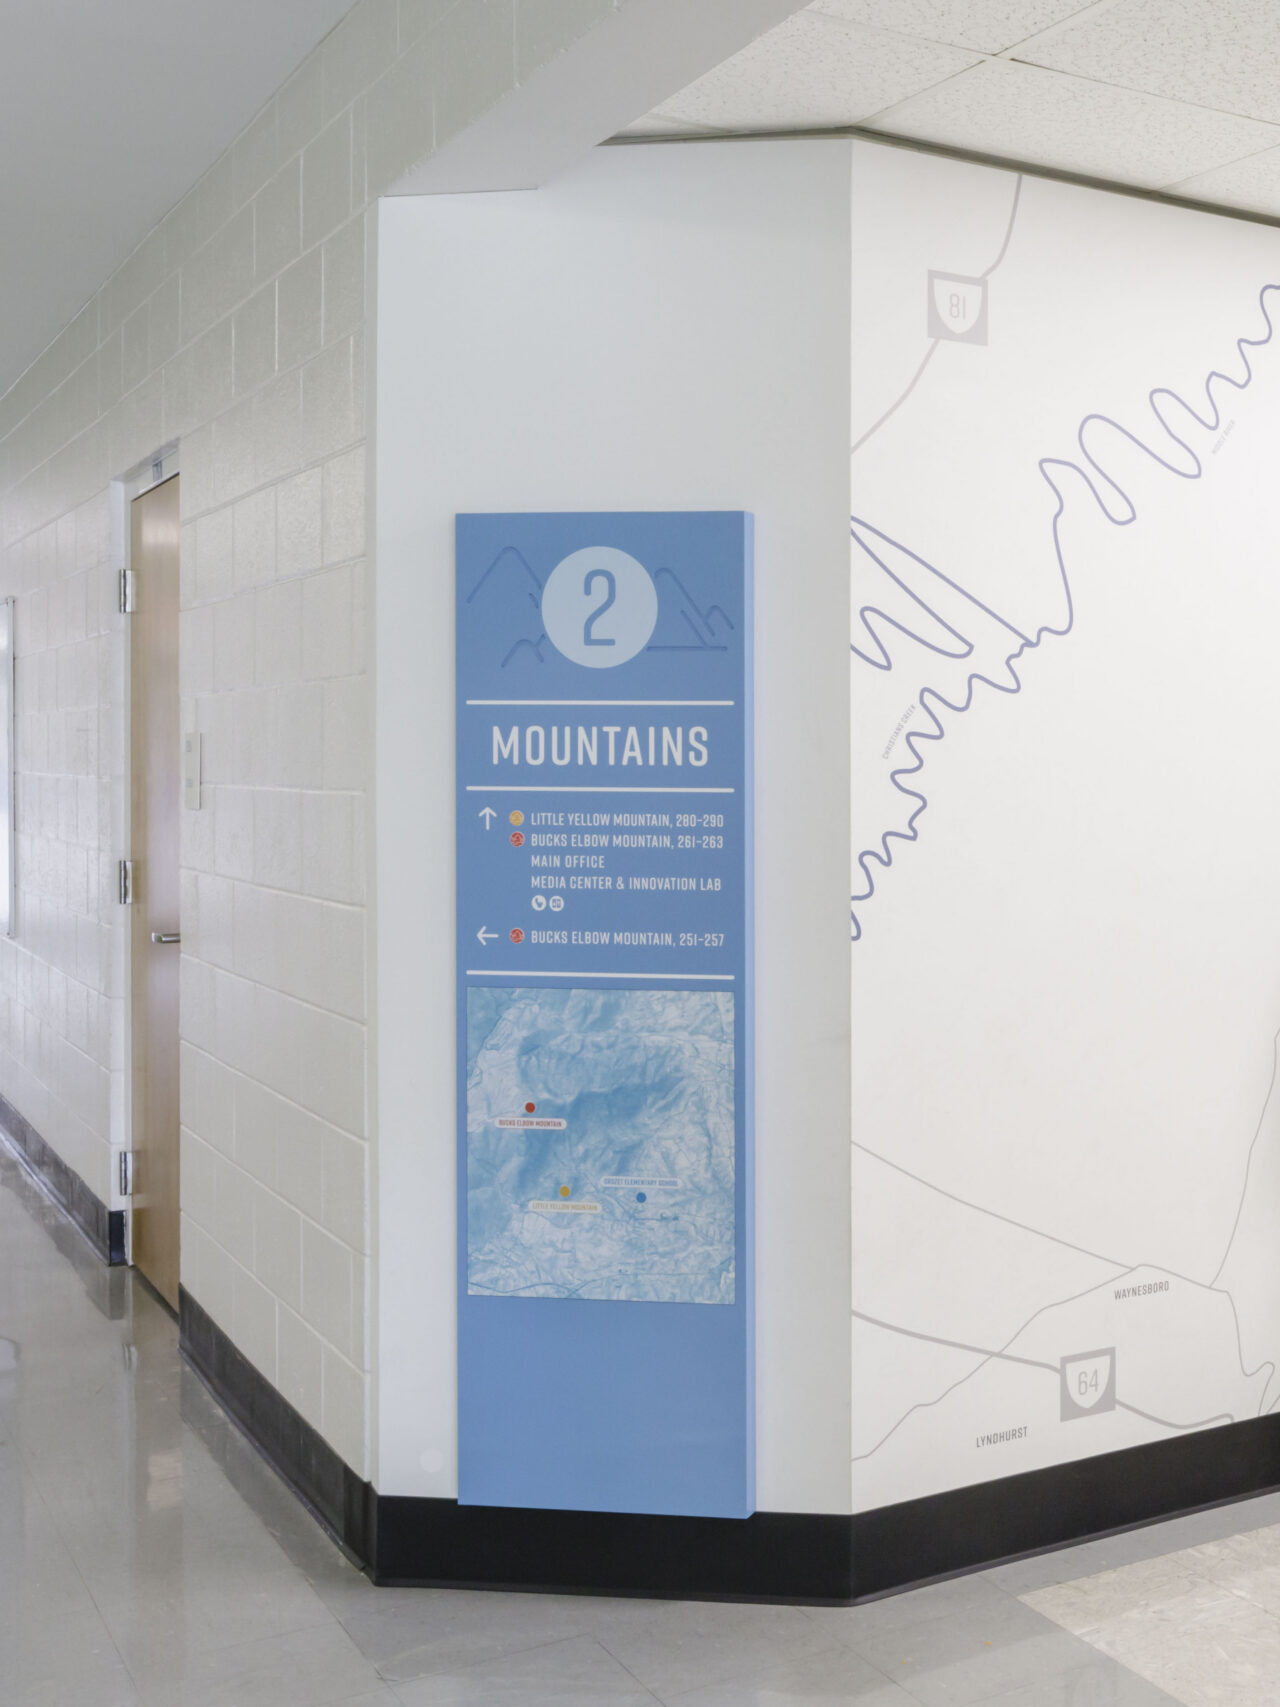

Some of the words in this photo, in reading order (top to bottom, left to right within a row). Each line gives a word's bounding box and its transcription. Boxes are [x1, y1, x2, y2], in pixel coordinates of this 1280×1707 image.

[949, 293, 966, 321] 81
[583, 568, 616, 647] 2
[492, 725, 708, 767] MOUNTAINS
[531, 812, 565, 826] LITTLE
[568, 813, 610, 827] YELLOW
[614, 814, 673, 829] MOUNTAIN,
[676, 814, 724, 829] 280-290
[531, 834, 568, 847] BUCKS
[571, 834, 609, 848] ELBOW
[613, 834, 675, 850] MOUNTAIN,
[678, 836, 723, 849] 261-263
[531, 856, 561, 868] MAIN
[565, 856, 605, 869] OFFICE
[531, 876, 567, 890] MEDIA
[570, 876, 612, 890] CENTER
[616, 877, 625, 890] &
[629, 877, 696, 891] INNOVATION
[700, 878, 721, 892] LAB
[531, 930, 568, 944] BUCKS
[572, 931, 610, 945] ELBOW
[614, 932, 676, 948] MOUNTAIN,
[679, 934, 724, 948] 251-257
[1114, 1280, 1170, 1300] WAYNESBORO
[1078, 1367, 1100, 1396] 64
[976, 1426, 1028, 1448] LYNDHURST
